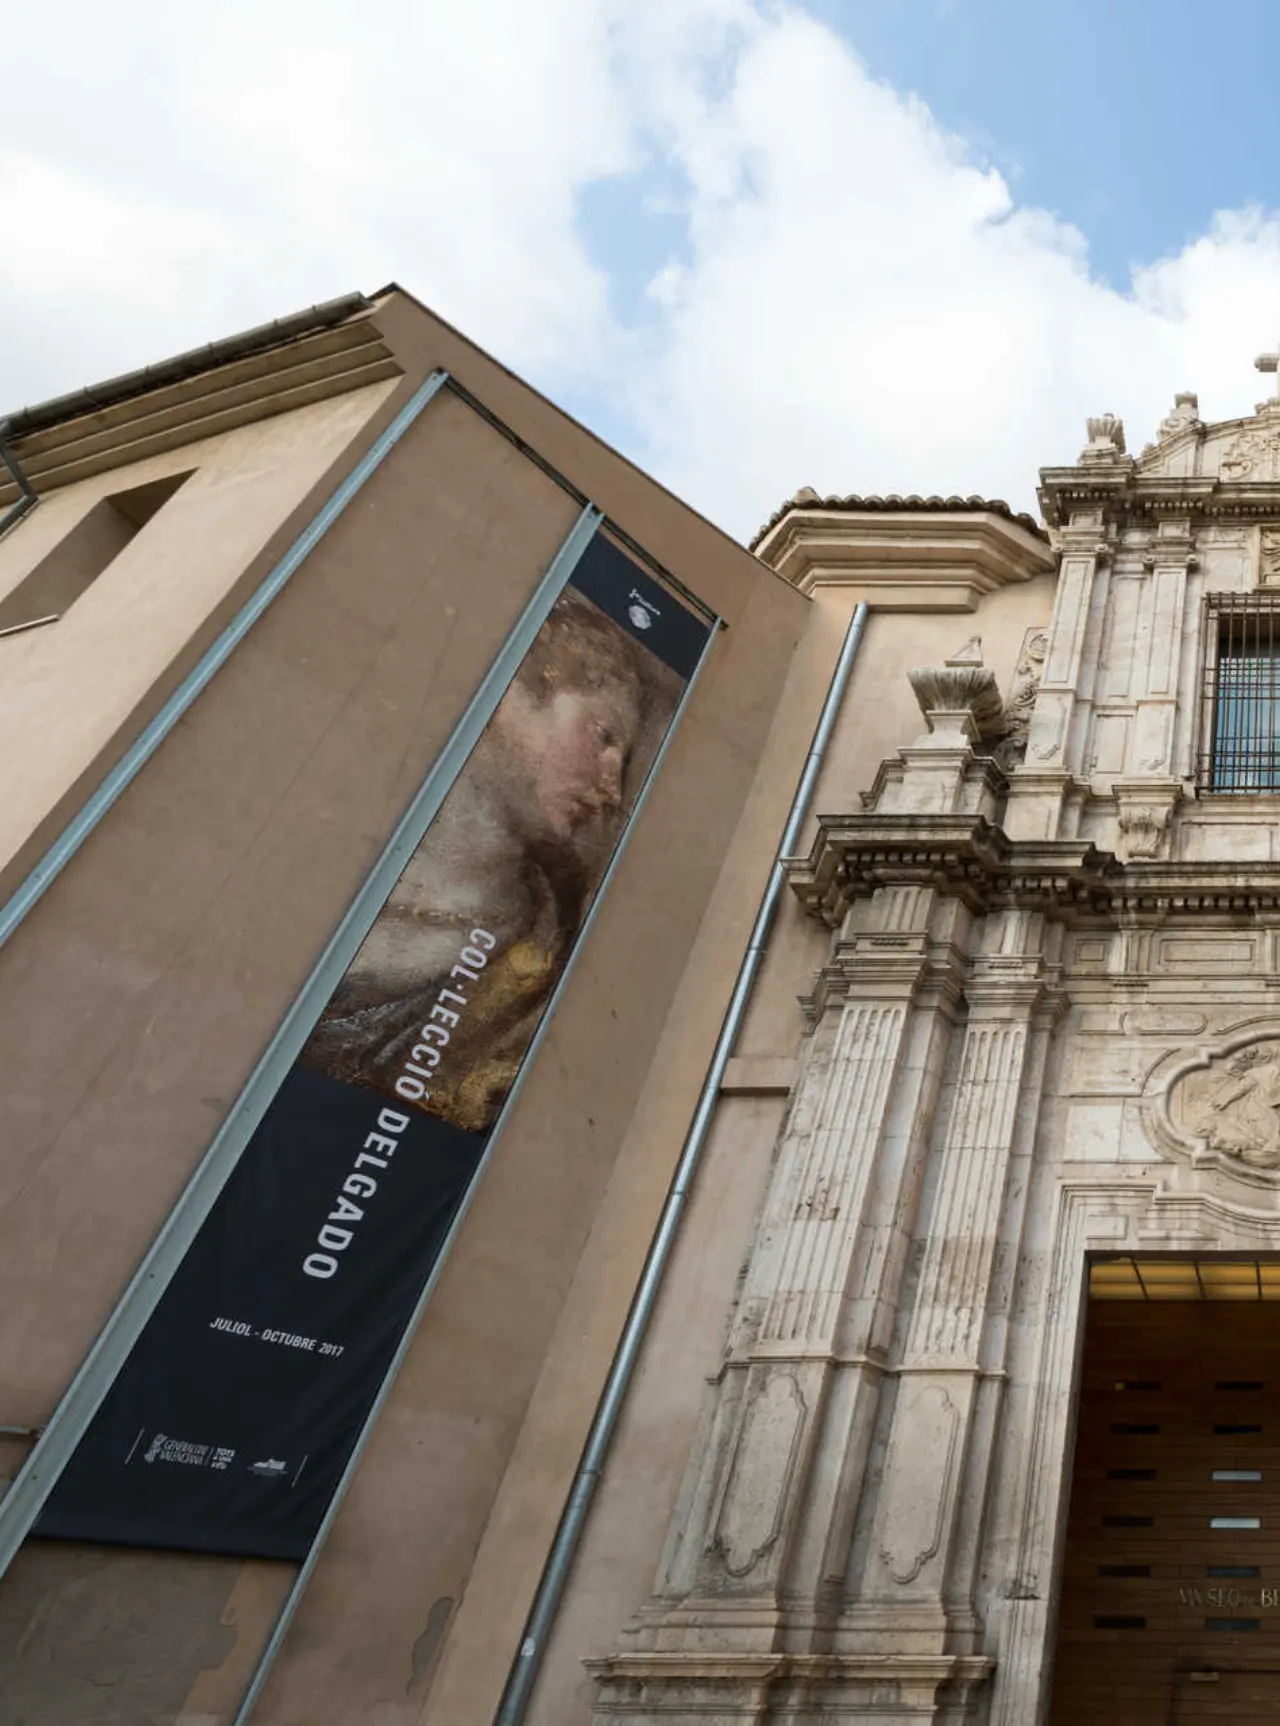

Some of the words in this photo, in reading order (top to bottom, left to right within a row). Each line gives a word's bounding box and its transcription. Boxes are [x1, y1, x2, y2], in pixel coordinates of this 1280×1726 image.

[302, 1107, 411, 1279] DELGADO
[209, 1317, 251, 1336] JULIOL
[261, 1328, 317, 1351] OCTUBRE
[318, 1342, 345, 1357] 2017
